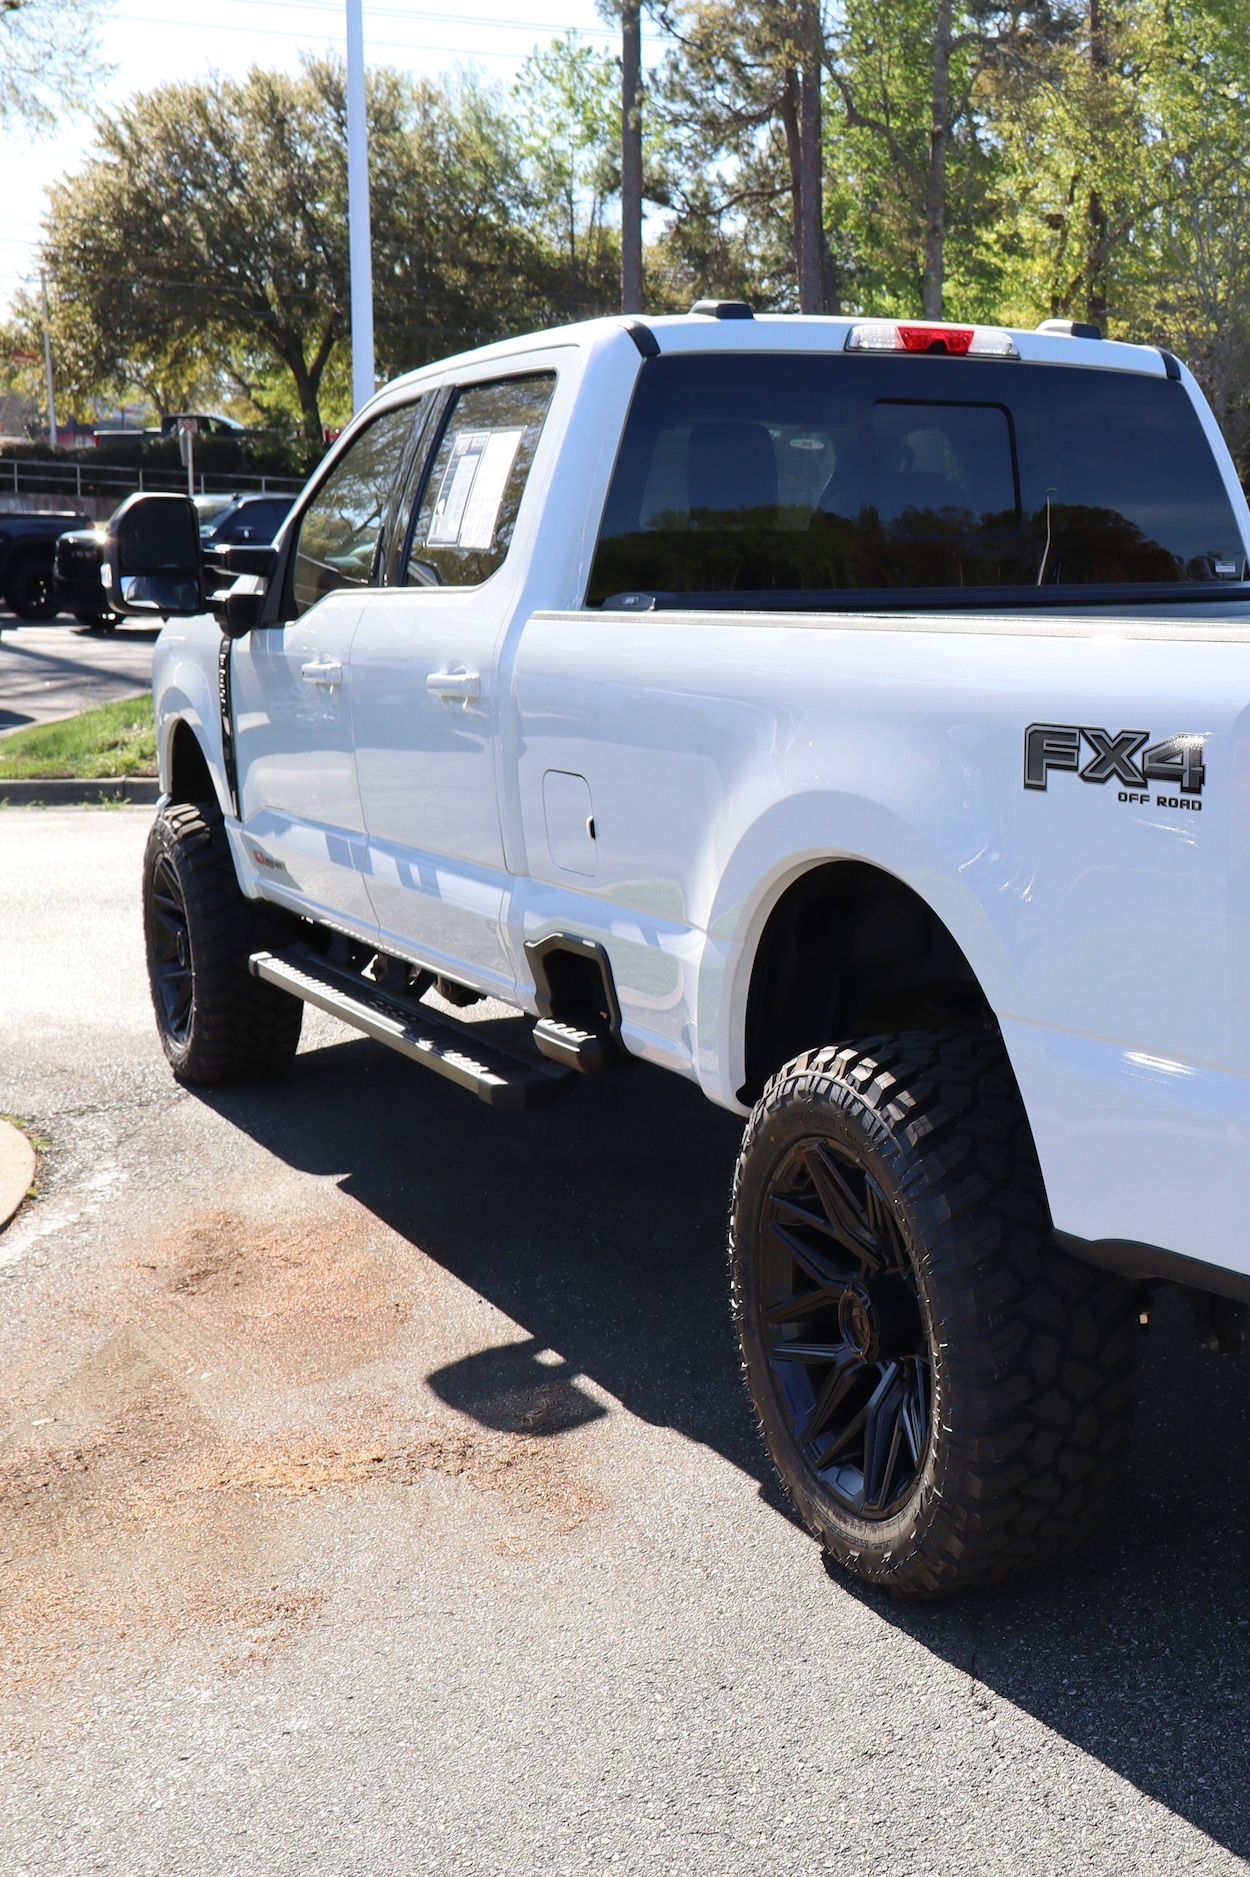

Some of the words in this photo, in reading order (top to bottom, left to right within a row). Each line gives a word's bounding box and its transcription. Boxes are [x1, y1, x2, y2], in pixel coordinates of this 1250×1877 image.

[1024, 720, 1206, 795] FX4
[1117, 791, 1150, 804] OFF
[1156, 795, 1202, 811] ROAD
